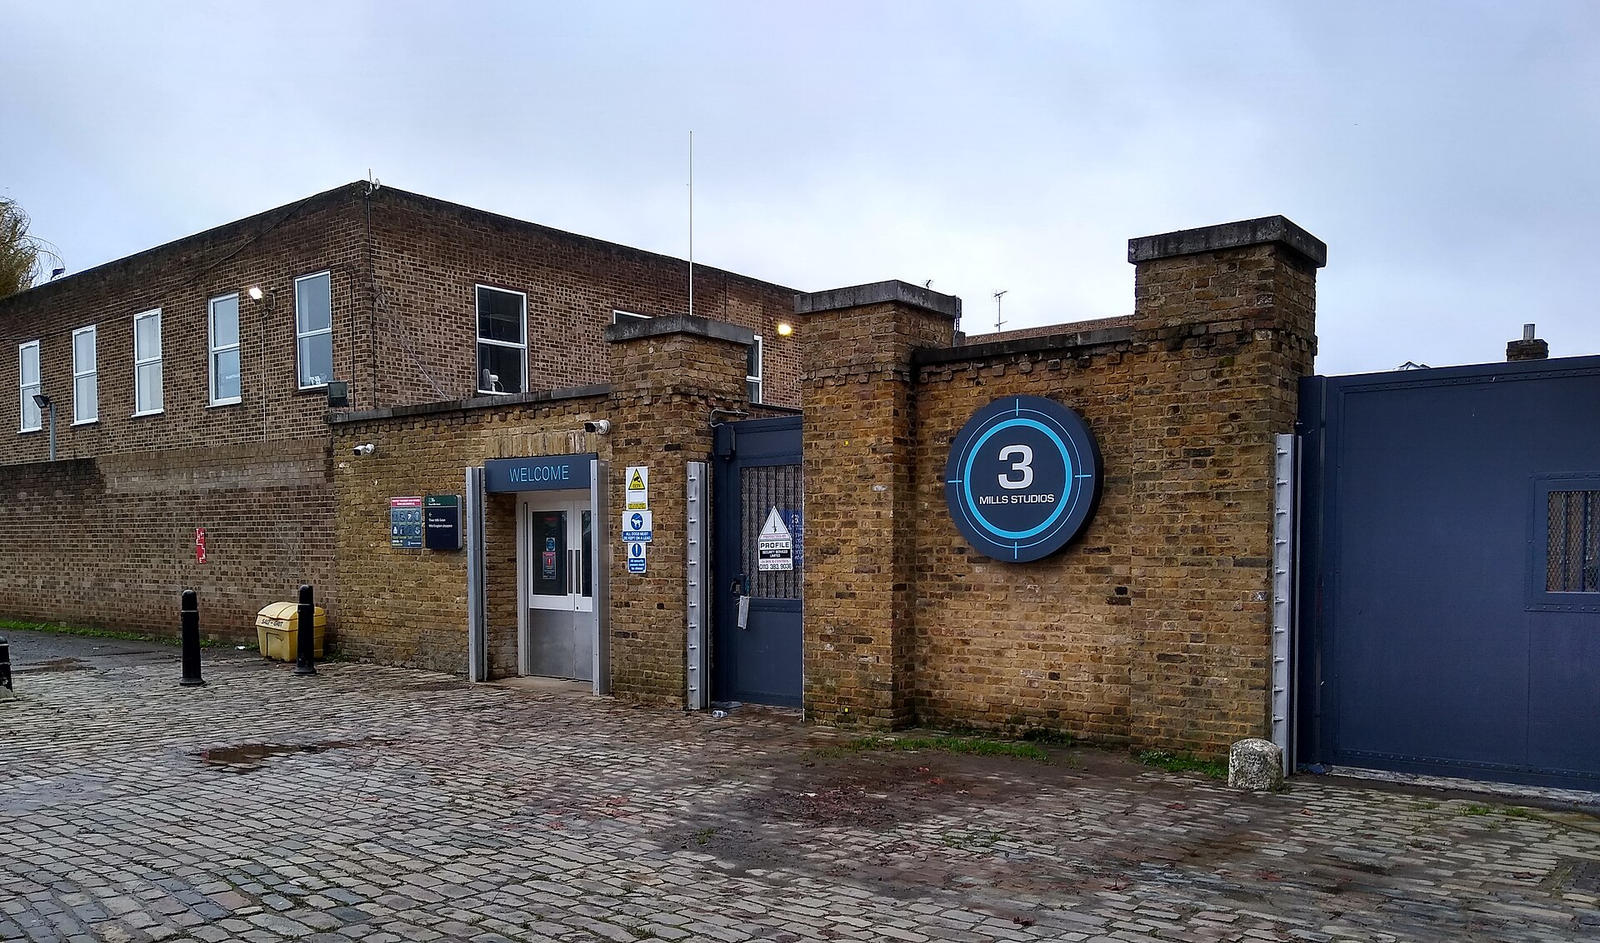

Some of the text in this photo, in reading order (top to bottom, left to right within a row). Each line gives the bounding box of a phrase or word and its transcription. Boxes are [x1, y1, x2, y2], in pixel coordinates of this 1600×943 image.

[509, 465, 569, 482] WELCOME
[998, 444, 1034, 490] 3
[979, 494, 1055, 505] MILLS STUDIOS
